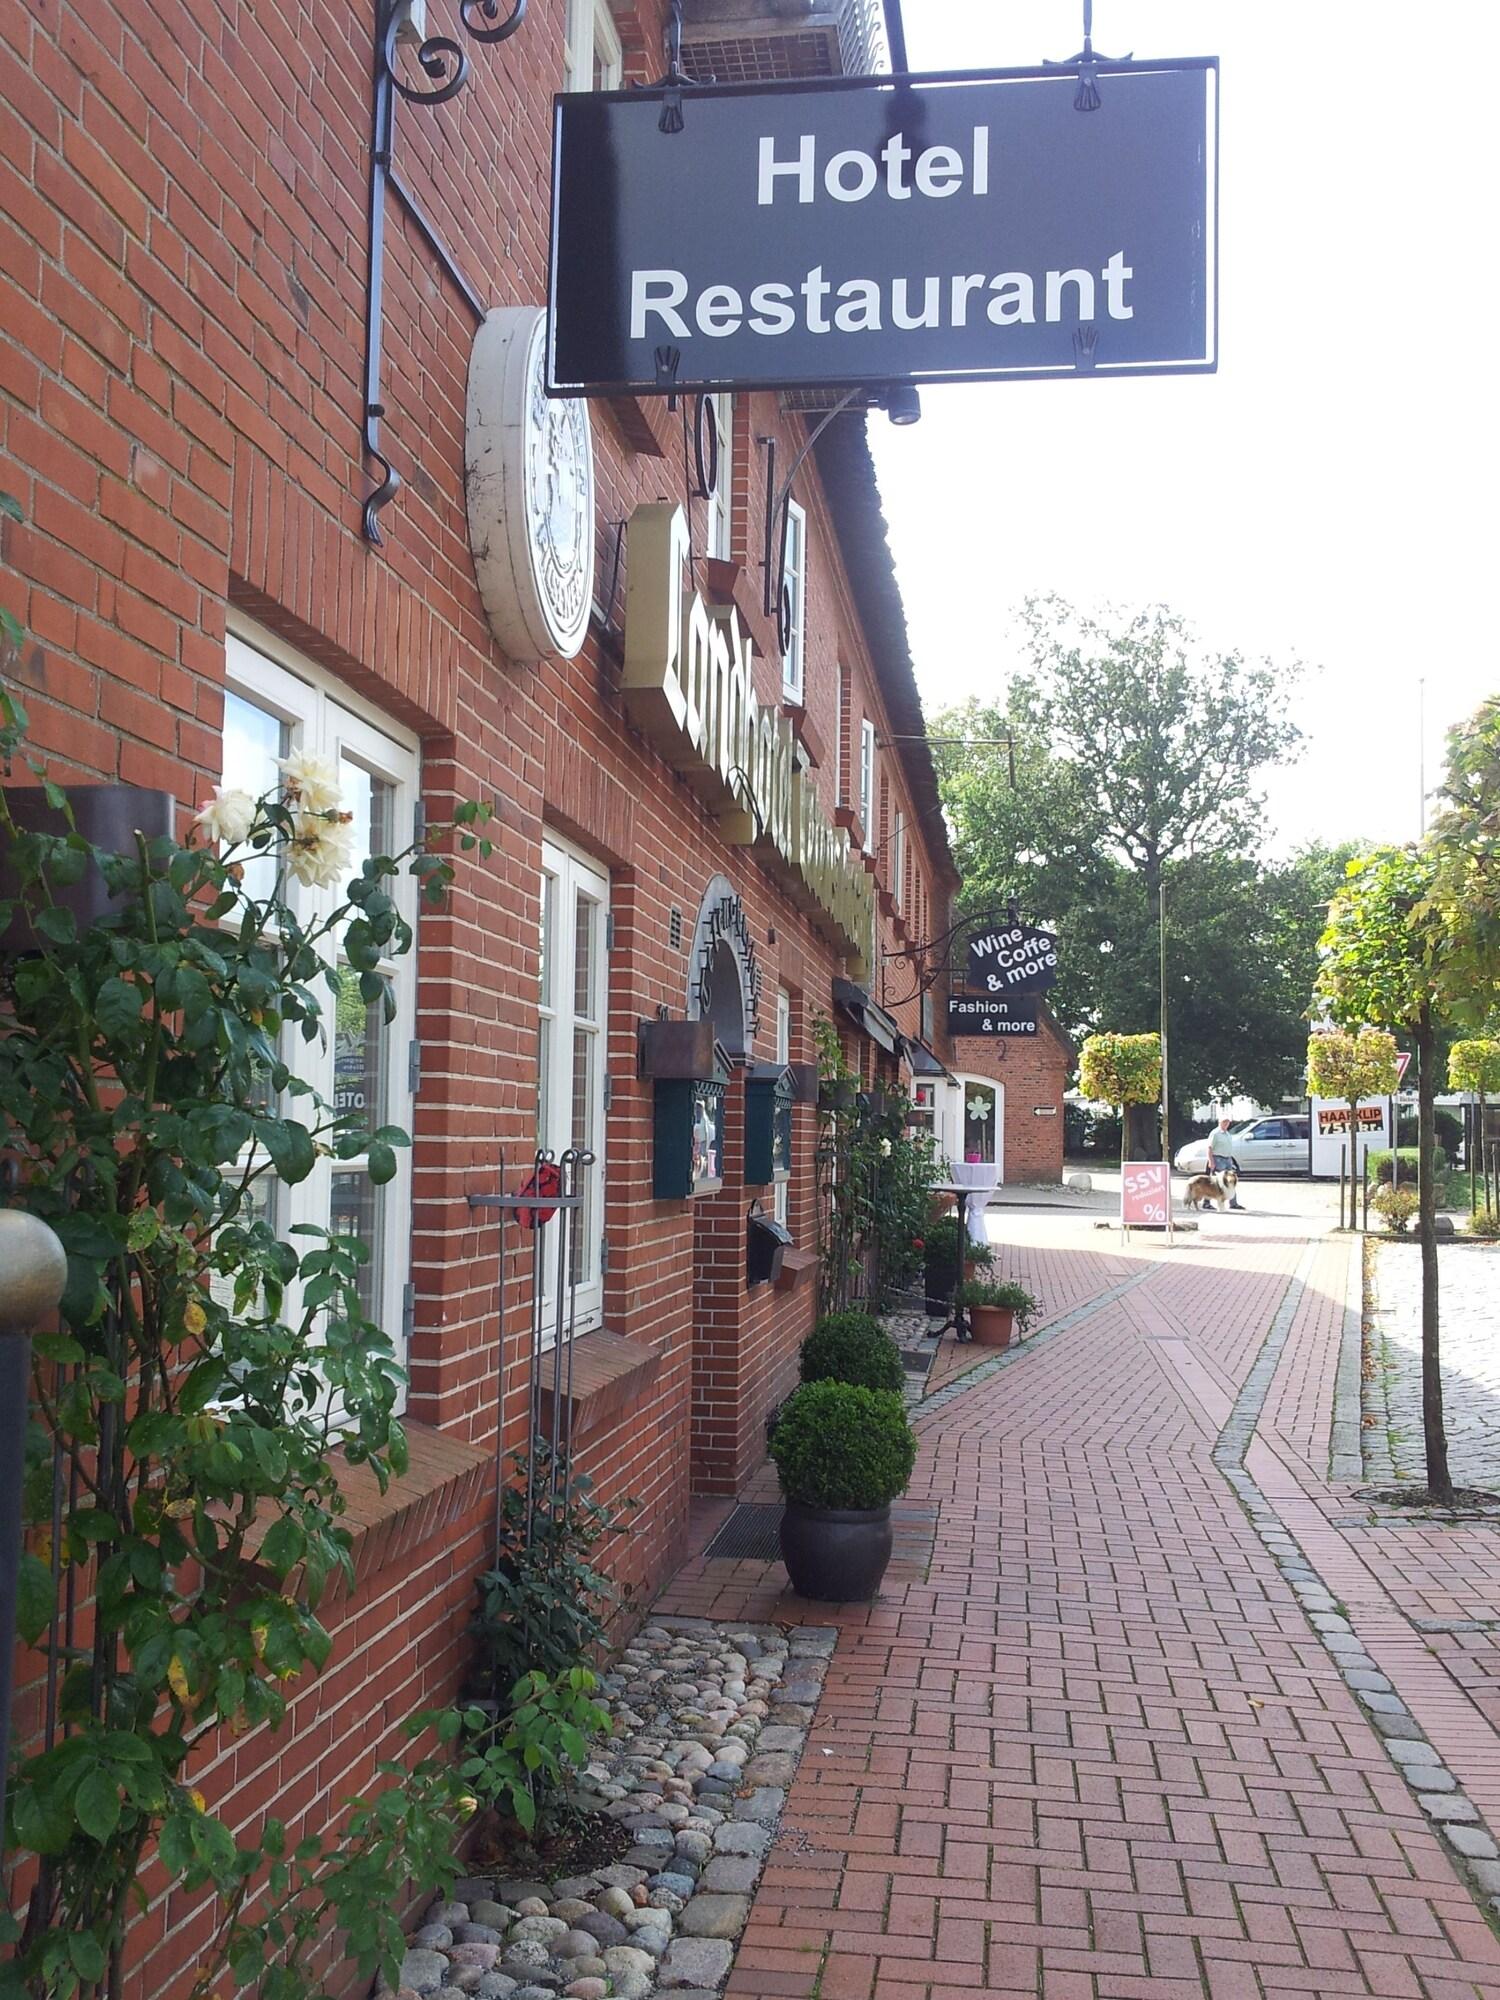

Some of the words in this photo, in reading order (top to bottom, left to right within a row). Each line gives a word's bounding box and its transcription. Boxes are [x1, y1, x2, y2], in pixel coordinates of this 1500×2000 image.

[757, 125, 989, 206] Hotel
[629, 249, 1135, 340] Restaurant
[970, 928, 1024, 958] Wine
[996, 937, 1051, 968] Coffe
[986, 974, 1004, 992] &
[1005, 952, 1058, 985] more
[949, 1000, 1008, 1014] Fashion
[981, 1018, 993, 1032] &
[997, 1021, 1035, 1032] more
[1125, 1166, 1162, 1194] SSV
[1143, 1203, 1166, 1222] %
